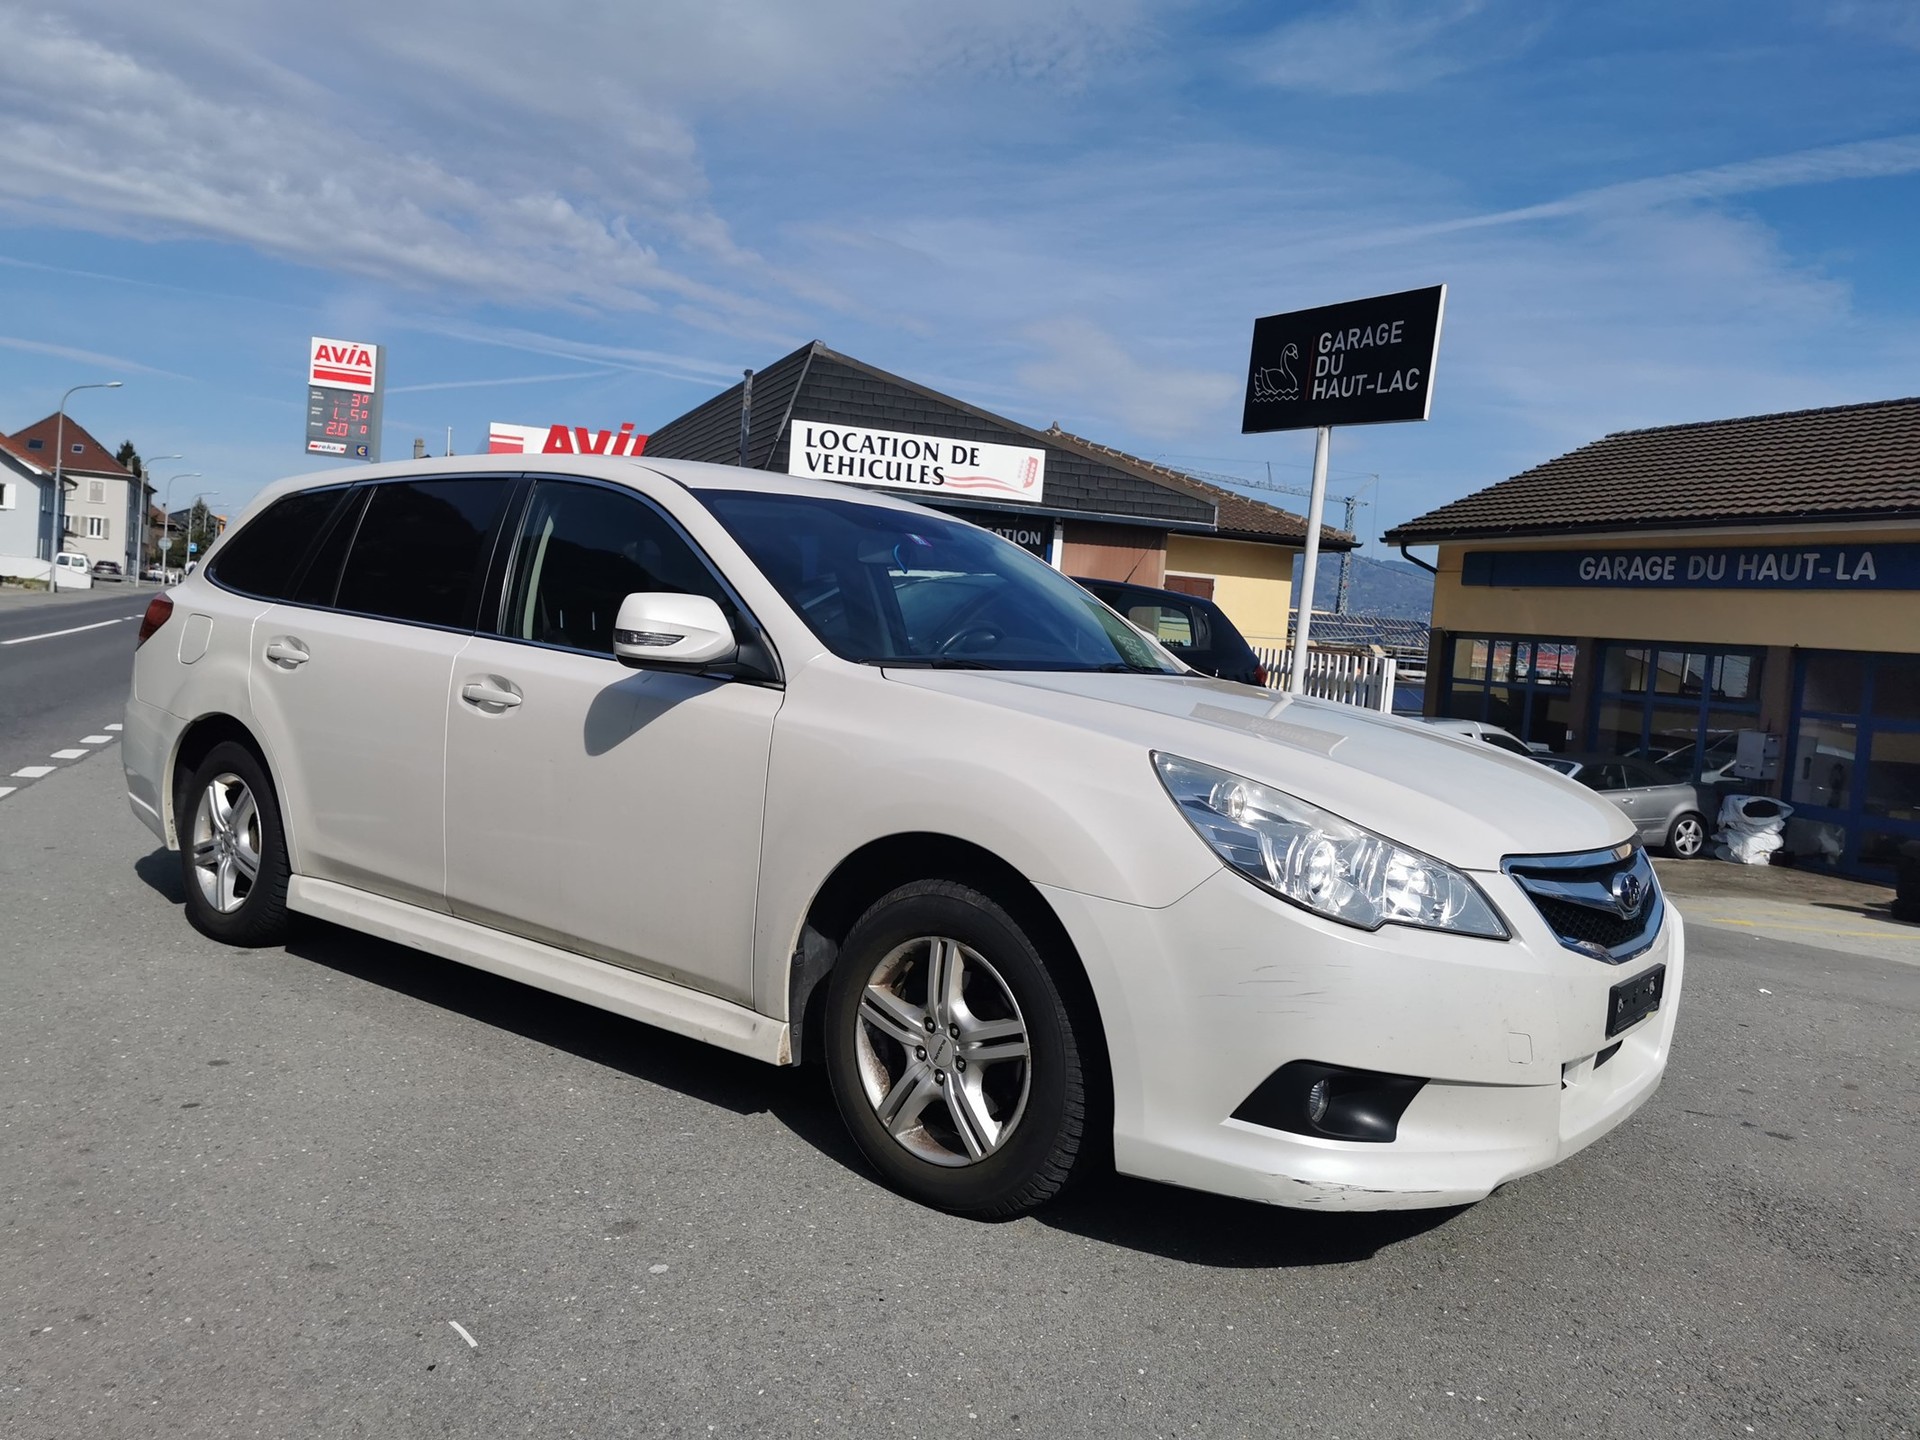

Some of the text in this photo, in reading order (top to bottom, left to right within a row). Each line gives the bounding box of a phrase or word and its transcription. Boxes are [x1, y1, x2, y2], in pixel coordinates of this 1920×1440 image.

[1318, 320, 1405, 354] GARAGE
[1315, 353, 1344, 377] DU
[1312, 367, 1420, 401] HAUT-LAC
[805, 427, 981, 467] LOCATION DE
[805, 451, 945, 486] VEHICULES
[1578, 551, 1878, 581] GARAGE DU HAUT-LA
